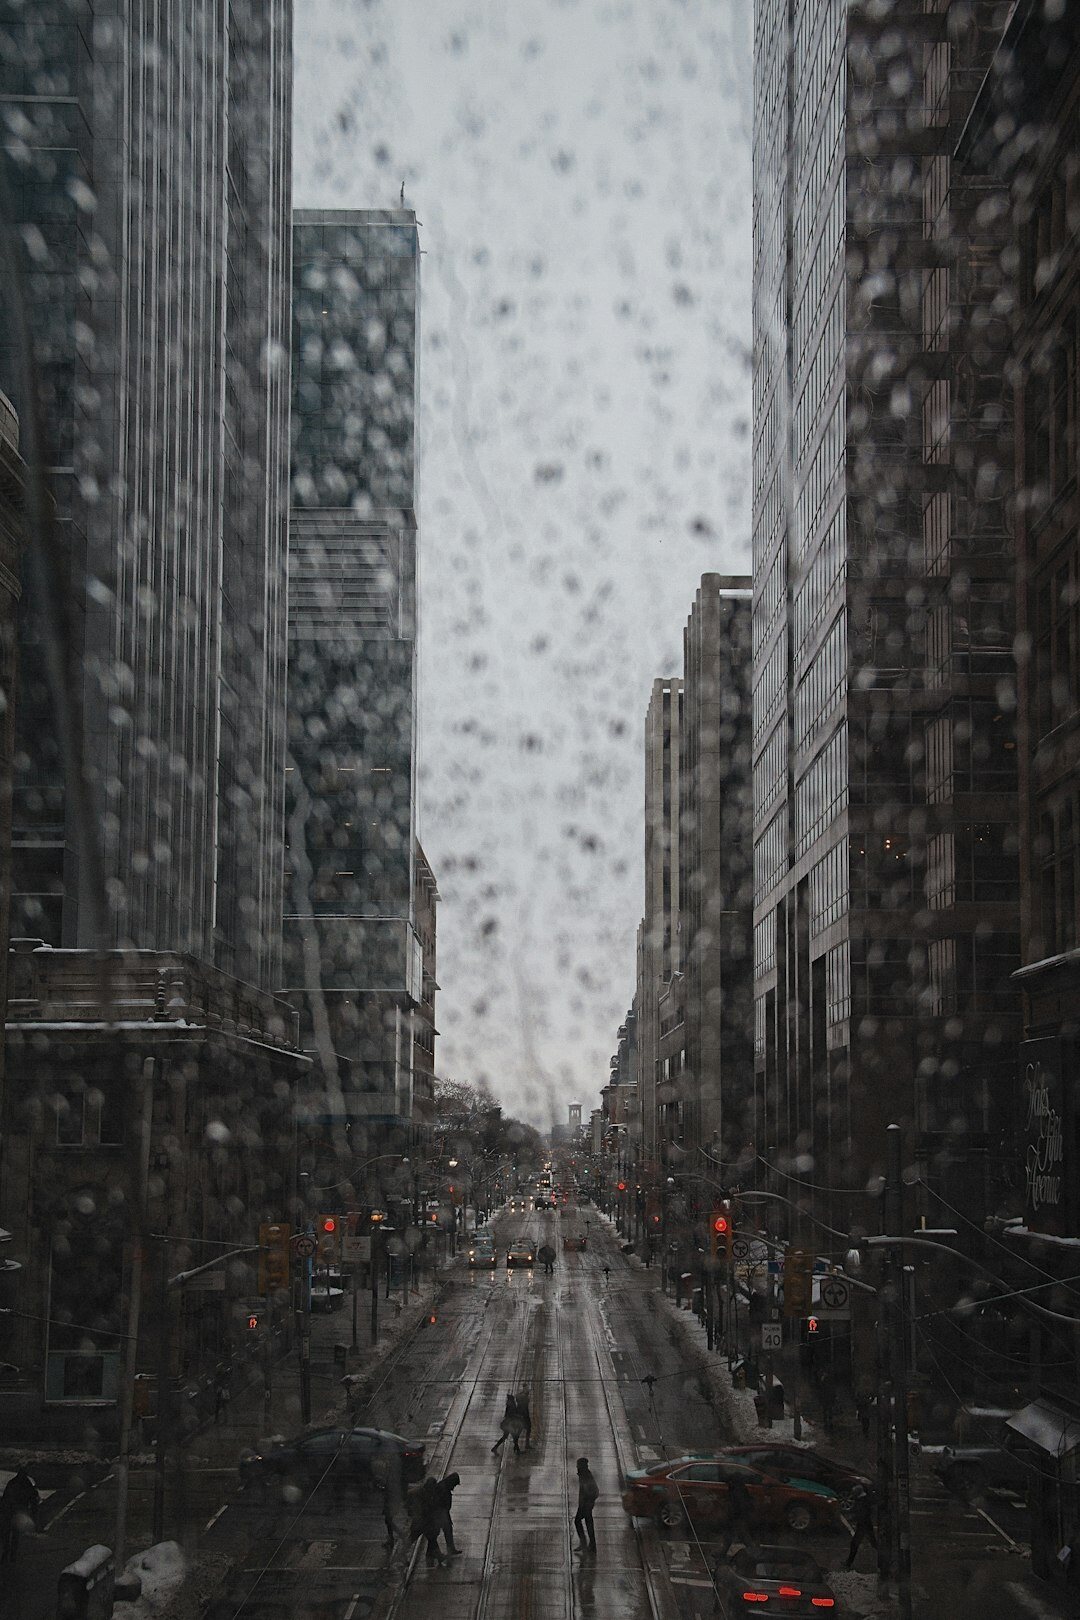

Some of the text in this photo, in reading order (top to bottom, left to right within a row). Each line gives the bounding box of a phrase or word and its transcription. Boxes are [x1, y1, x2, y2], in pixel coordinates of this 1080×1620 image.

[1024, 1061, 1049, 1131] Saks
[1037, 1106, 1063, 1172] Fifth
[1025, 1144, 1061, 1211] Avenue
[765, 1334, 780, 1346] 40
